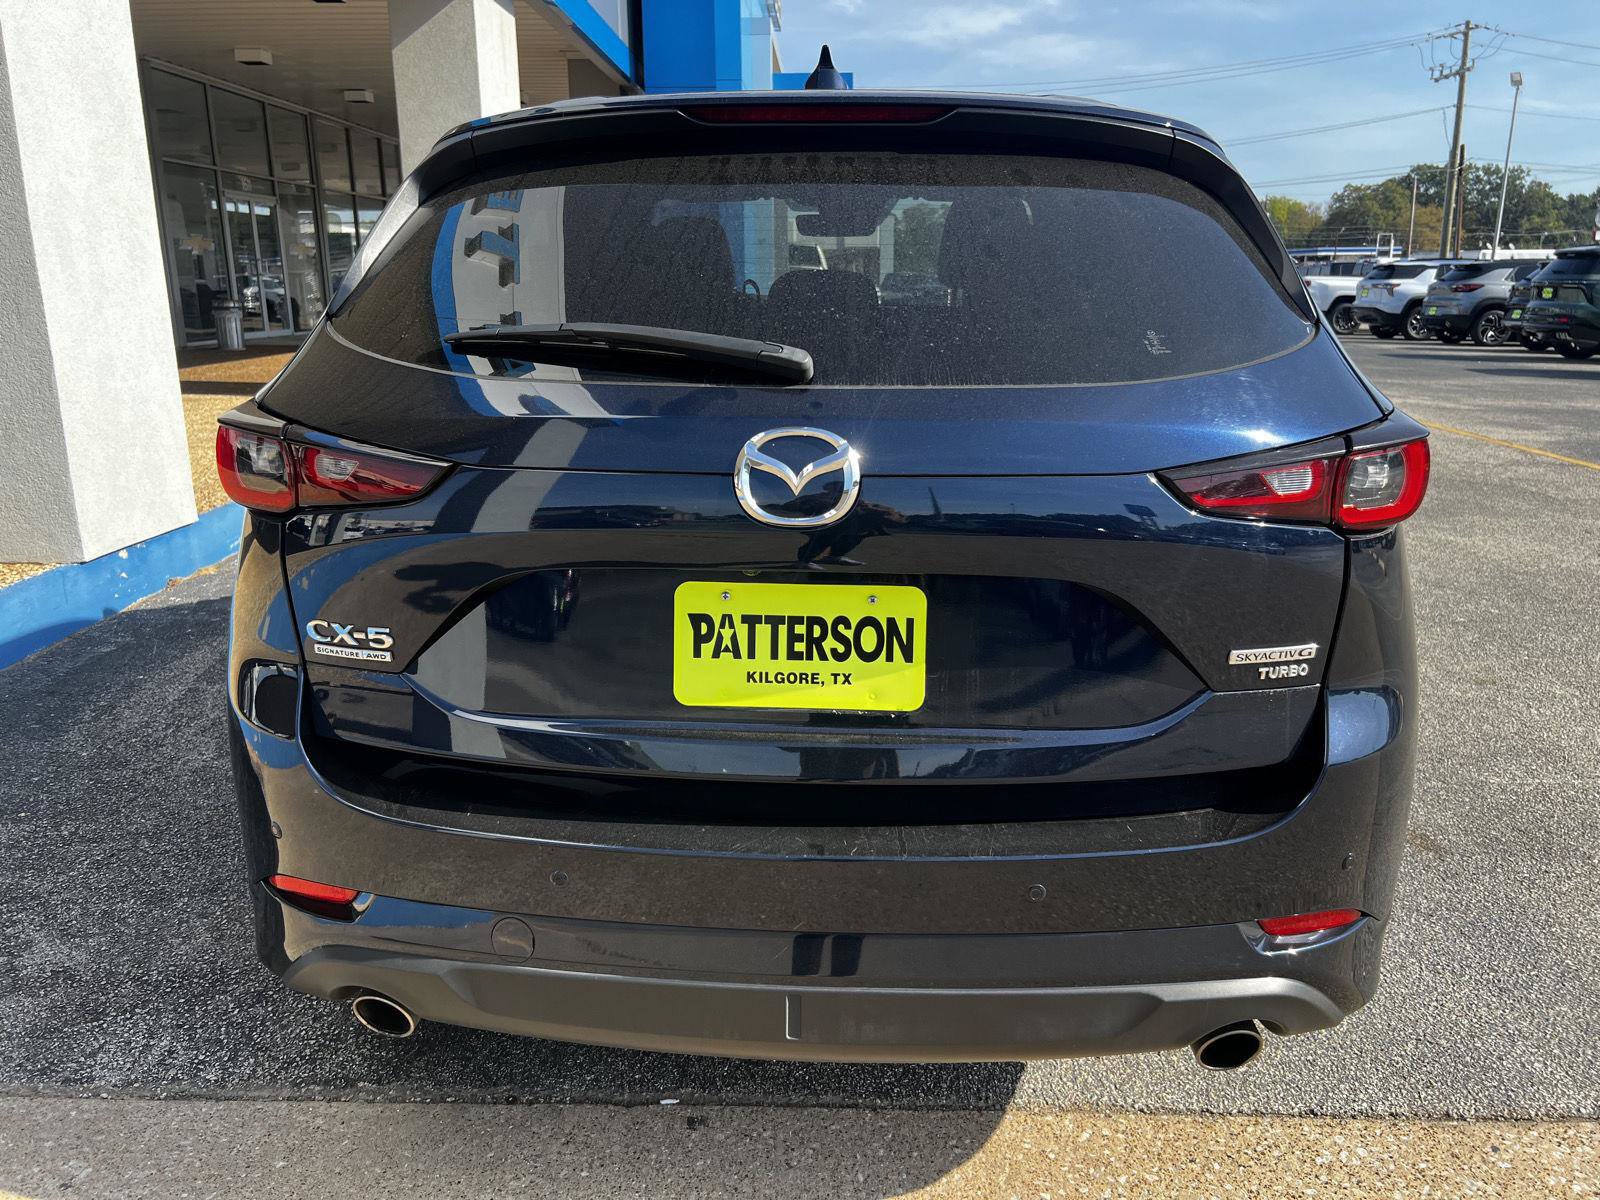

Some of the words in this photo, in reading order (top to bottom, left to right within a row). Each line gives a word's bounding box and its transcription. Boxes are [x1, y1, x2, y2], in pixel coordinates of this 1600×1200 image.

[306, 619, 394, 649] CX-5
[687, 613, 915, 664] PATTERSON
[316, 646, 361, 659] SIGNATURE
[366, 652, 387, 660] AWD
[746, 671, 825, 687] KILGORE,
[831, 673, 852, 686] TX
[1258, 663, 1309, 680] TURBO
